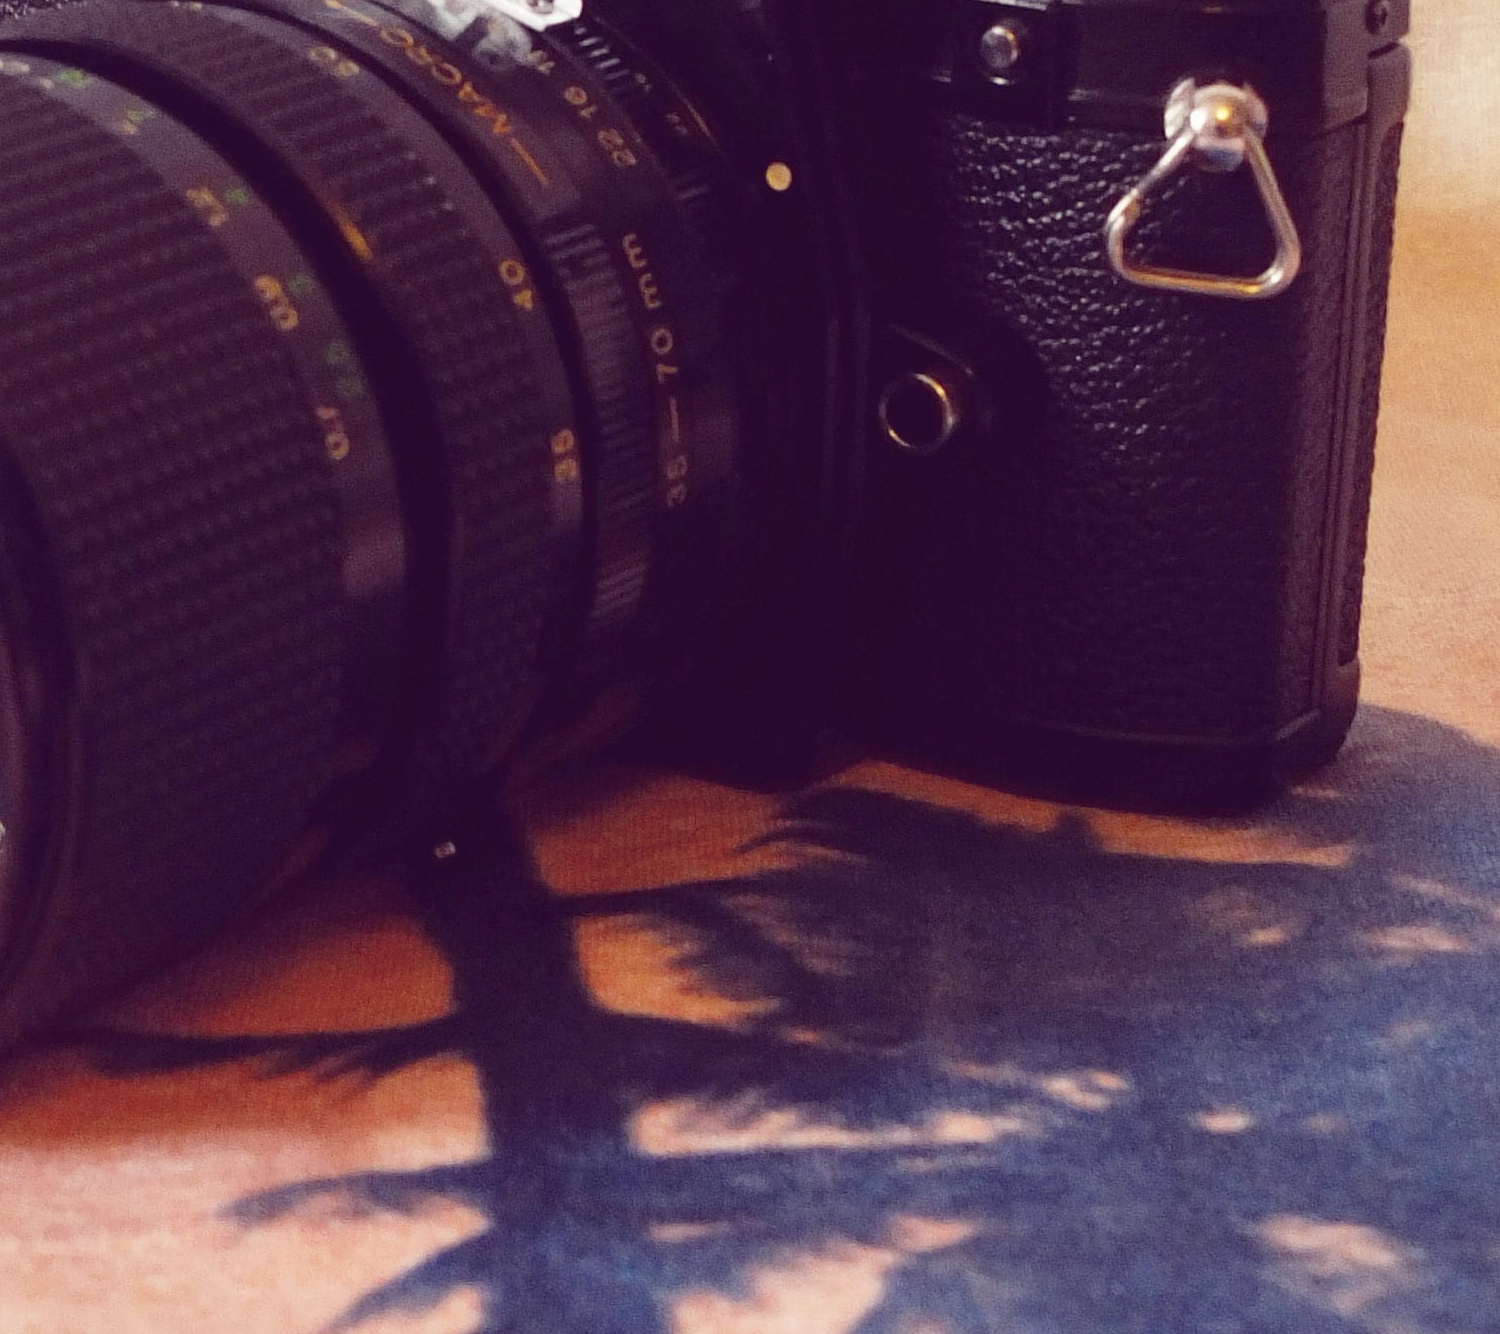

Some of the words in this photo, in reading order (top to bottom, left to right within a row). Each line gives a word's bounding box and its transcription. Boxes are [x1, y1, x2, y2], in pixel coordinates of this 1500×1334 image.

[379, 24, 513, 135] MACRO
[498, 257, 536, 312] 40
[621, 230, 663, 311] mm
